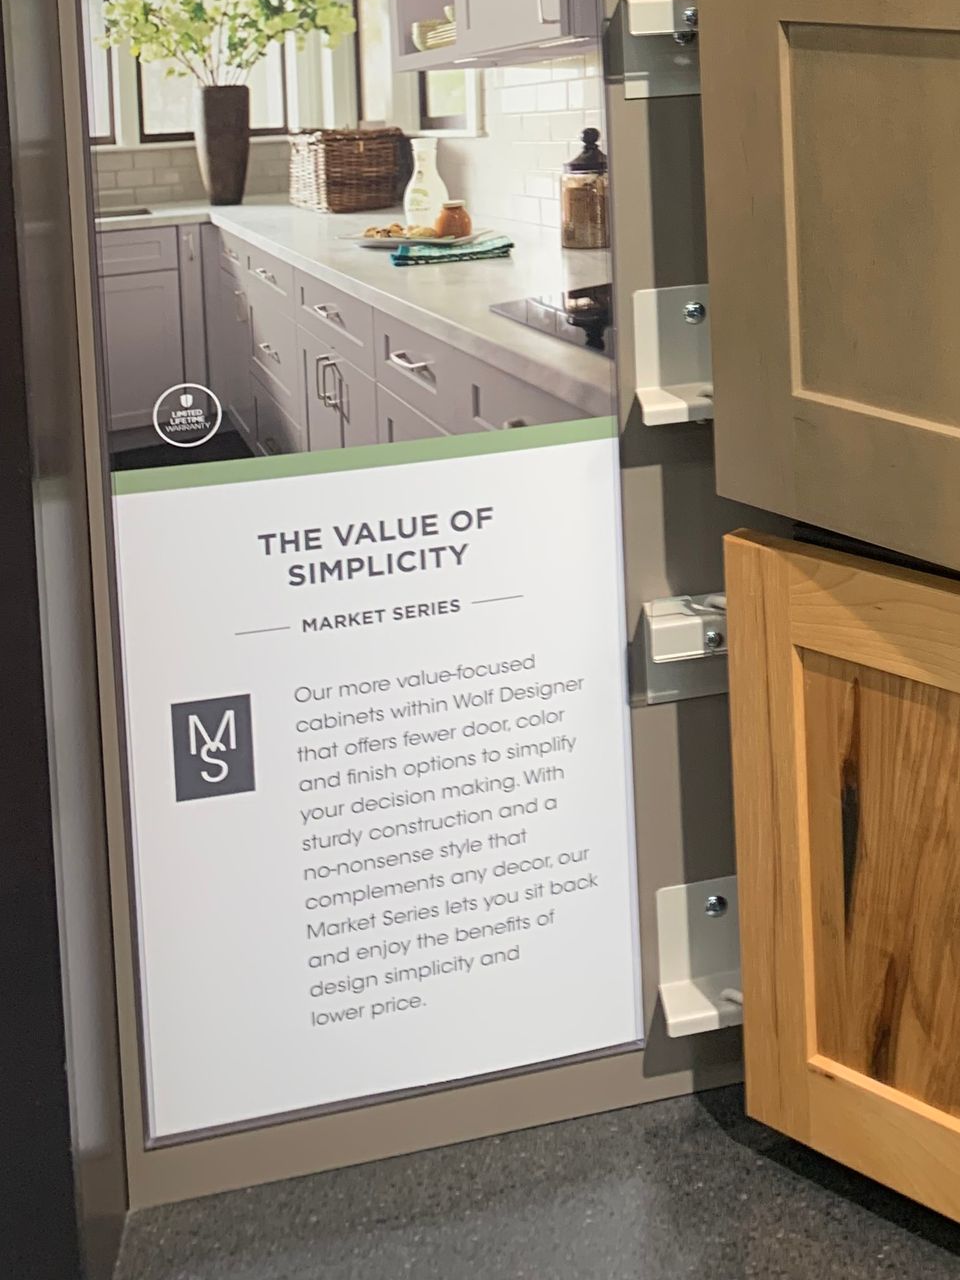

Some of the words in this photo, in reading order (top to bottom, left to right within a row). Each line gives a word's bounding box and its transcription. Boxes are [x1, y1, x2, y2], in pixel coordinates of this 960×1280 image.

[165, 422, 211, 432] WARRANTY
[257, 527, 323, 556] THE
[332, 513, 440, 547] VALUE
[450, 506, 494, 533] OF
[288, 543, 469, 587] SIMPLICITY
[302, 608, 387, 633] MARKET
[392, 598, 461, 621] SERIES
[293, 686, 333, 704] Our
[338, 678, 392, 698] more
[395, 653, 536, 693] value-focused
[295, 706, 385, 733] cabinets
[389, 697, 449, 720] within
[452, 688, 494, 710] Wolf
[499, 678, 585, 703] Designer
[296, 741, 339, 763] that
[344, 736, 398, 756] offers
[402, 727, 457, 747] fewer
[461, 719, 512, 738] door,
[515, 709, 566, 729] color
[298, 770, 341, 793] and
[346, 763, 397, 785] finish
[402, 753, 477, 779] options
[481, 748, 502, 764] to
[506, 734, 577, 760] simplify
[299, 803, 345, 826] your
[350, 789, 436, 814] decision
[441, 776, 521, 800] making.
[522, 765, 565, 785] With
[301, 828, 363, 852] sturdy
[368, 809, 493, 841] construction
[498, 797, 539, 819] and
[544, 797, 558, 811] a
[303, 848, 435, 881] no-nonsense
[439, 838, 483, 859] style
[487, 828, 527, 849] that
[304, 873, 445, 911] complements
[450, 867, 488, 885] any
[492, 855, 554, 878] decor,
[557, 848, 590, 866] our
[306, 913, 377, 940] Market
[382, 905, 440, 927] Series
[445, 896, 478, 916] lets
[483, 891, 519, 912] you
[524, 883, 545, 901] sit
[549, 872, 599, 896] back
[307, 946, 350, 969] and
[355, 939, 412, 960] enjoy
[416, 932, 450, 950] the
[455, 915, 531, 943] benefits
[536, 908, 555, 927] of
[309, 974, 379, 998] design
[383, 955, 475, 985] simplicity
[479, 944, 520, 967] and
[311, 1005, 366, 1027] lower
[370, 995, 427, 1020] price.
